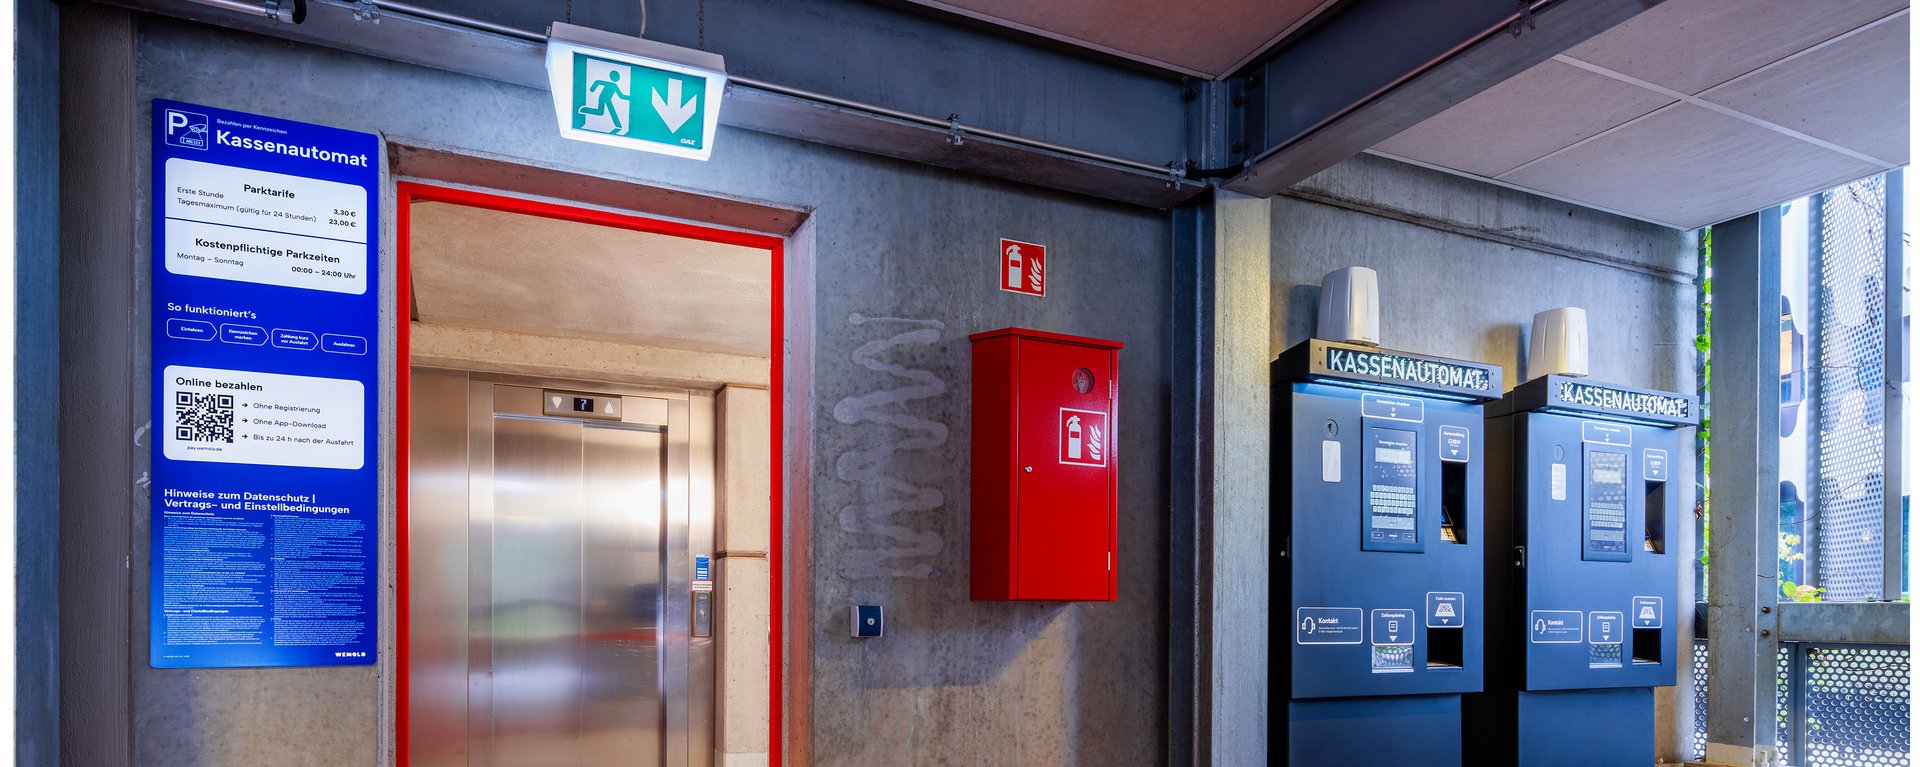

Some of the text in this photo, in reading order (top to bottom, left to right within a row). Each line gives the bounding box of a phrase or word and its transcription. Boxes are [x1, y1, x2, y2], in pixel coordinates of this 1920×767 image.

[168, 112, 188, 135] P
[216, 118, 242, 127] Bezahlen
[253, 125, 288, 134] Kennzeichen
[216, 129, 368, 167] Kassenautomat
[177, 186, 224, 199] Erste Stunde
[244, 184, 295, 199] Parktarife
[177, 198, 234, 212] Tagesmaximum
[236, 206, 260, 216] (gültig
[285, 212, 317, 223] Stunden)
[195, 238, 340, 264] Kostenpflichtige Parkzeiten
[177, 252, 205, 262] Montag
[214, 257, 244, 267] Sonntag
[291, 266, 313, 274] 00:00
[321, 270, 342, 278] 24:00
[167, 302, 182, 312] So
[1330, 350, 1483, 389] KASSENAUTOMAT
[176, 376, 263, 392] Online bezahlen
[1563, 382, 1684, 417] KASSENAUTOMAT
[274, 404, 321, 414] Registrierung
[274, 420, 326, 429] App-Download
[326, 438, 354, 446] Ausfahrt
[164, 488, 215, 499] Hinweise
[244, 492, 309, 502] Datenschutz
[164, 499, 218, 510] Vertrags-
[245, 502, 350, 515] Einstellbedingungen
